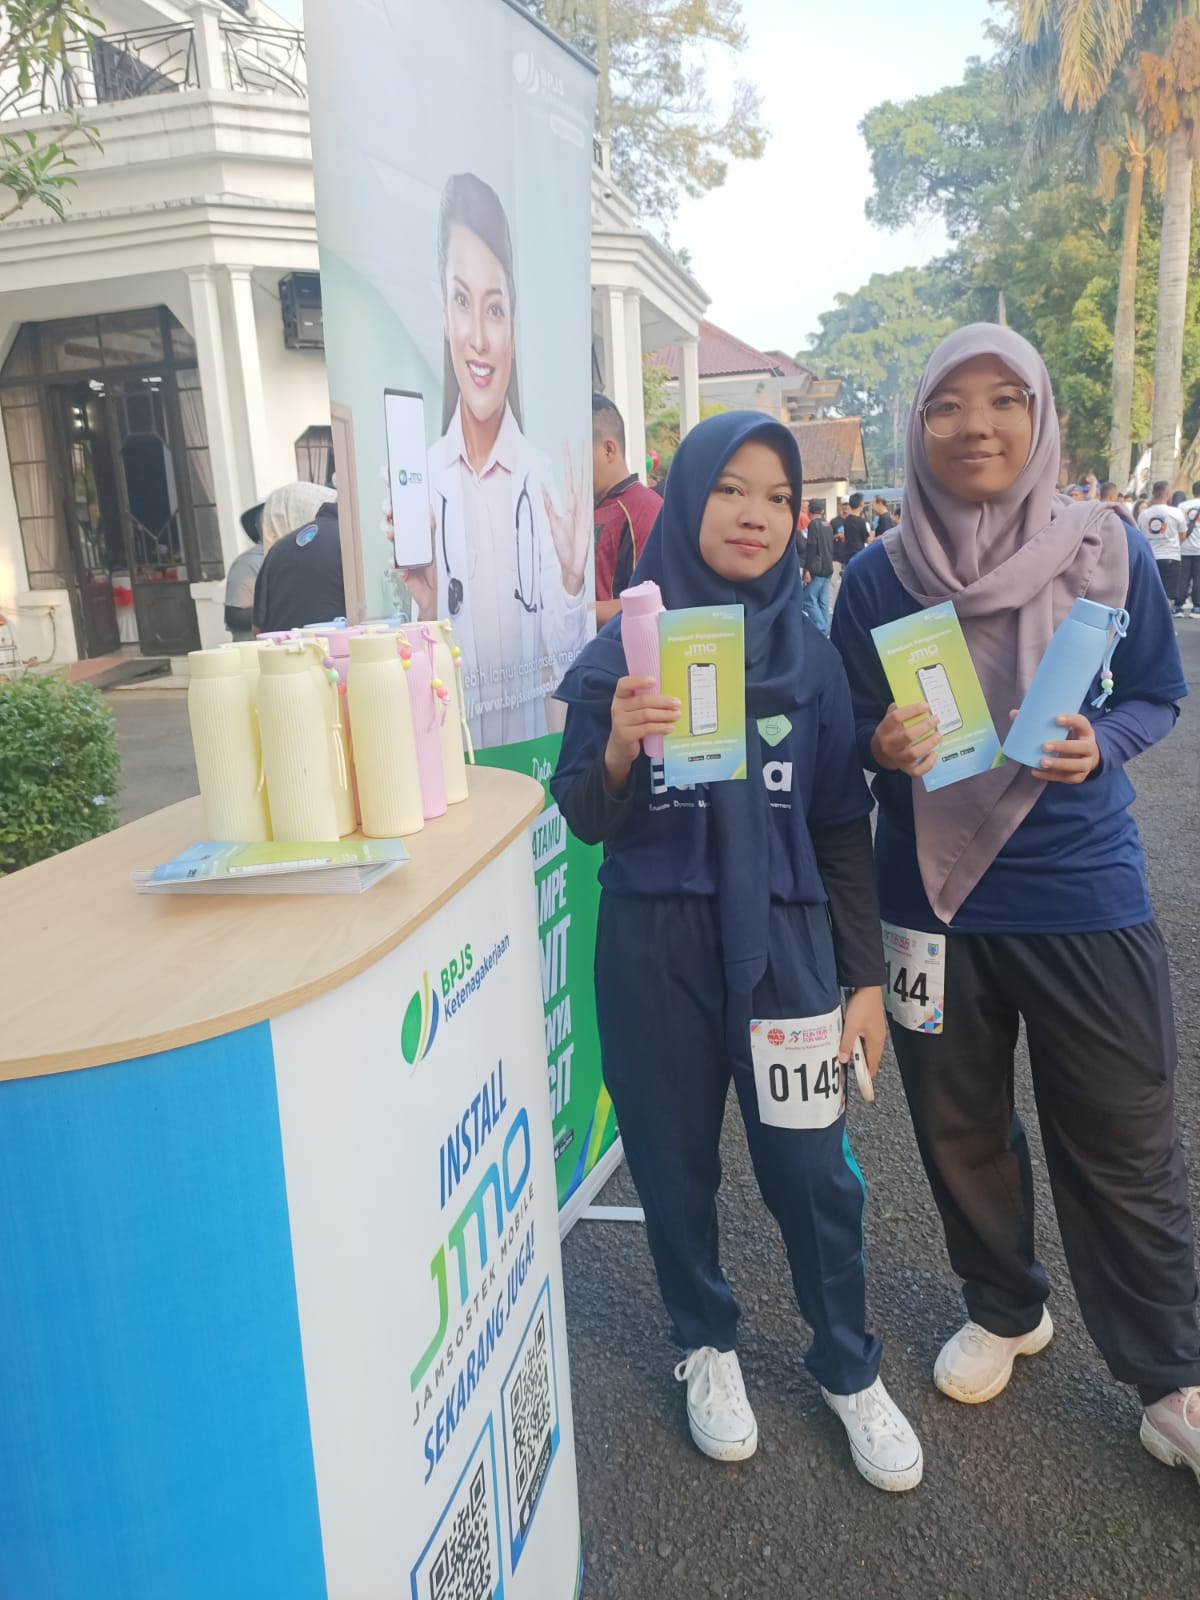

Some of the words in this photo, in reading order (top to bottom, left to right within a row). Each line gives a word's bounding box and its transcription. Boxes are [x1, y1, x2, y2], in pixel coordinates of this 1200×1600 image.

[535, 862, 569, 926] MPE
[440, 943, 474, 998] BPJS
[443, 934, 510, 1022] Ketenagakerjaan
[544, 994, 572, 1057] NYA
[769, 1055, 840, 1103] 0145
[440, 1058, 507, 1210] INSTALL
[412, 1267, 498, 1427] JAMSOSTEK
[499, 1181, 536, 1262] MOBILE
[424, 1292, 505, 1485] SEKARANG
[504, 1220, 536, 1323] JUGA!
